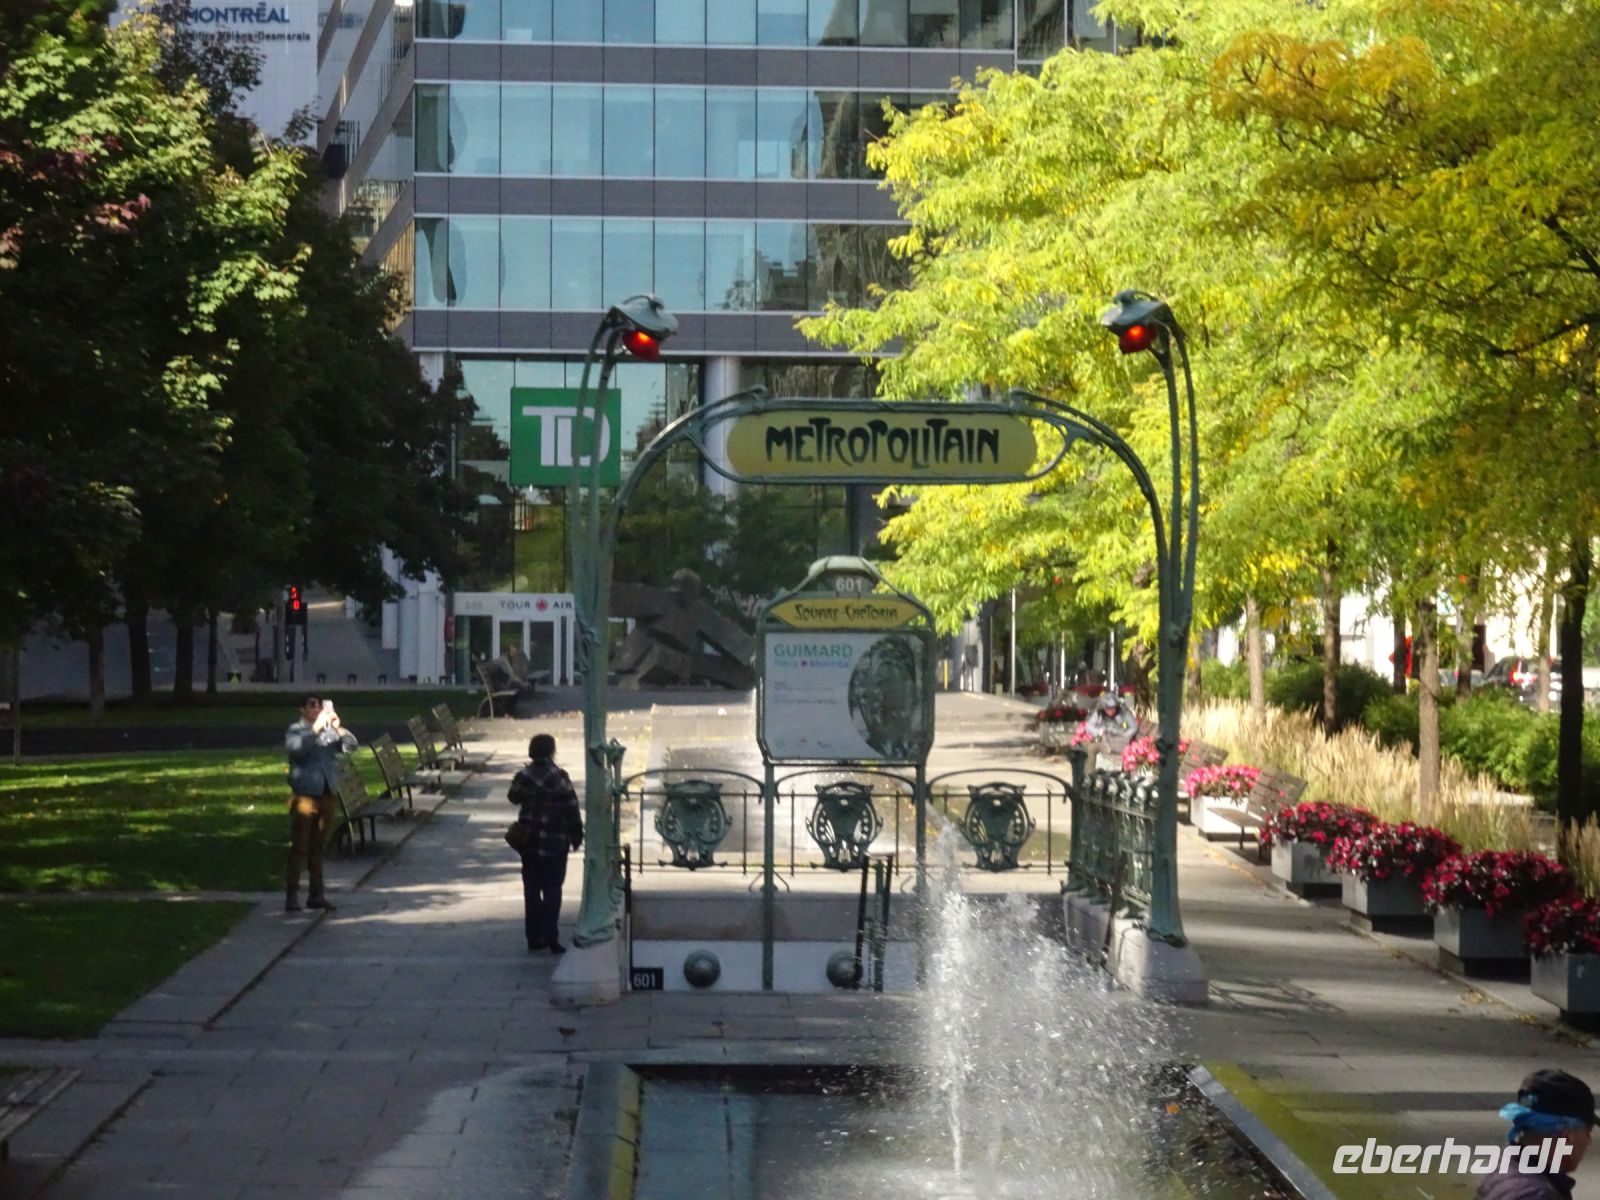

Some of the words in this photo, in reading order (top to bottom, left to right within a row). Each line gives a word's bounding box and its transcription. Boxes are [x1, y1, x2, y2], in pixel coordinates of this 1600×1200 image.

[522, 405, 611, 467] TD
[765, 417, 999, 470] METROPOLITAIN
[835, 577, 863, 592] 601
[499, 601, 531, 609] TOUR
[552, 601, 572, 609] AIR
[774, 644, 853, 657] GUIMARD
[633, 973, 656, 988] 601
